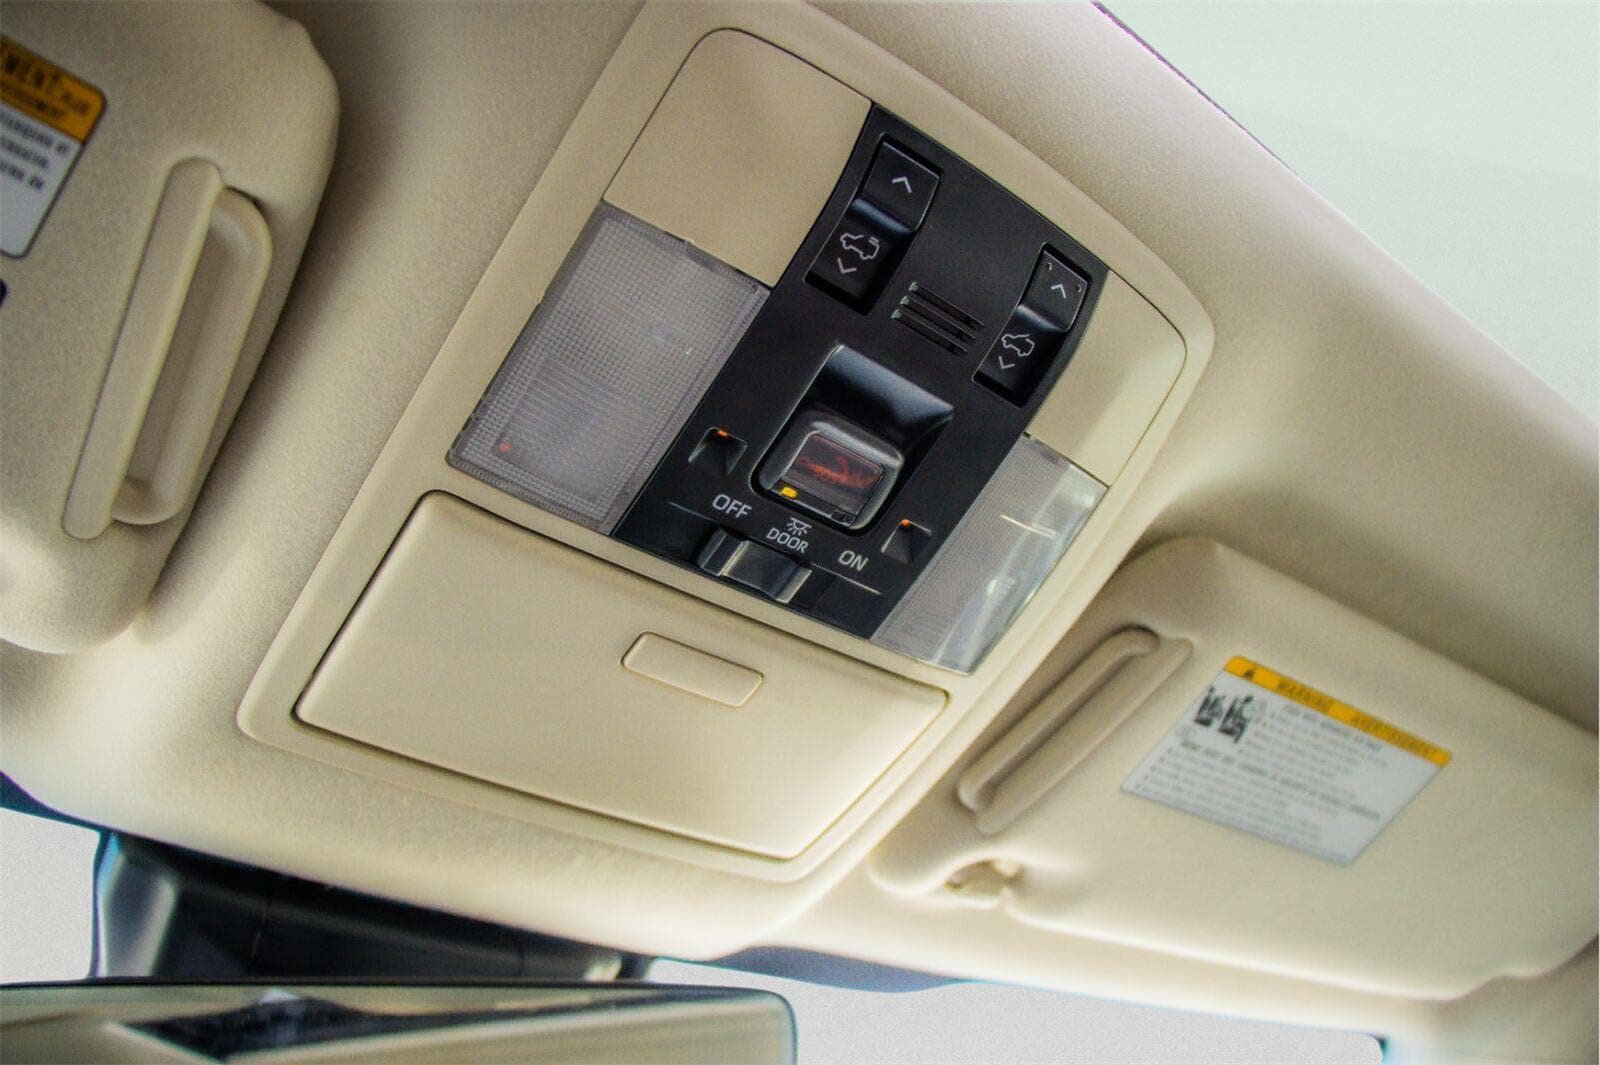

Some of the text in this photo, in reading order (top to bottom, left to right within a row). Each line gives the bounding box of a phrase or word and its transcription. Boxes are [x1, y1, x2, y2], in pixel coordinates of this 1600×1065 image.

[712, 494, 752, 518] OFF
[766, 528, 809, 553] DOOR
[838, 550, 869, 571] ON
